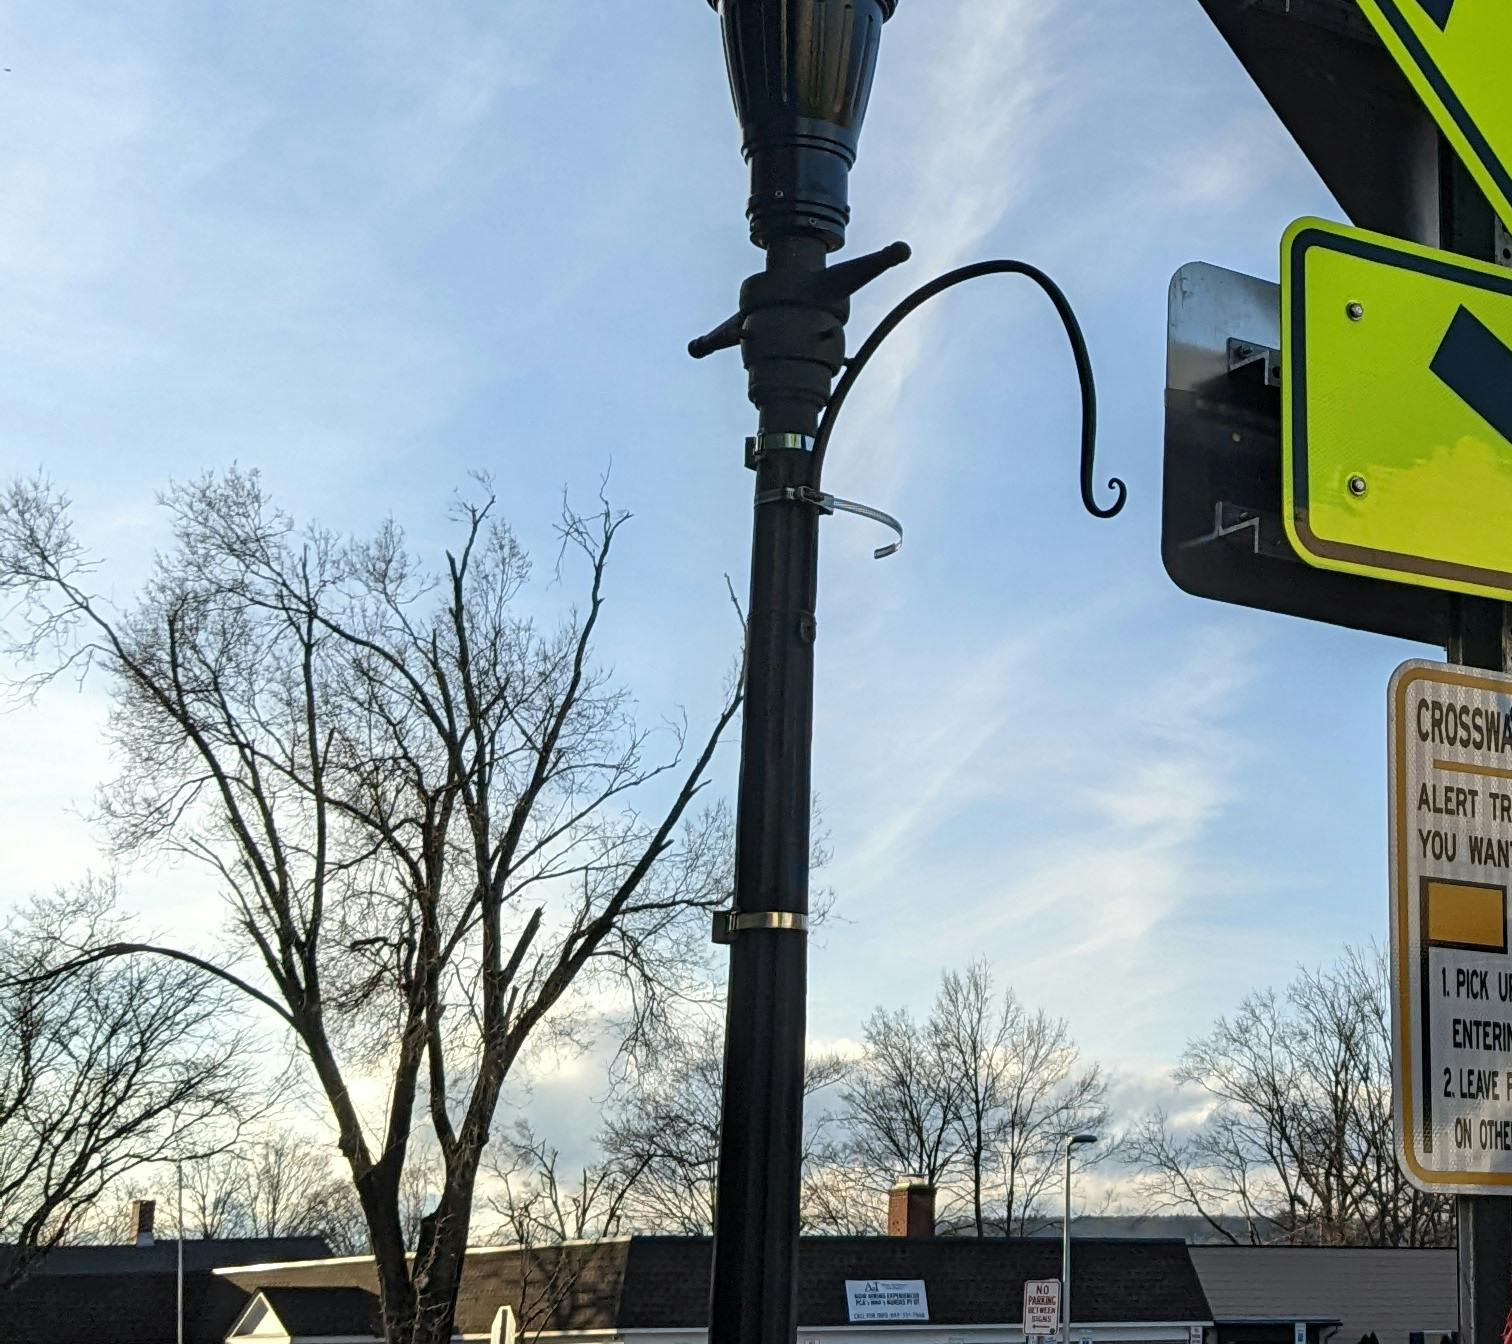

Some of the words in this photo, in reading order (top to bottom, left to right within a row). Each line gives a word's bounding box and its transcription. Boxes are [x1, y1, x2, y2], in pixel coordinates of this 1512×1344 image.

[1417, 782, 1478, 819] ALERT
[1417, 829, 1457, 863] YOU
[1441, 967, 1450, 998] 1.
[1456, 968, 1489, 1001] PICK
[1443, 1067, 1455, 1098] 2.
[1459, 1069, 1499, 1101] LEAVE
[1455, 1118, 1472, 1149] ON
[1028, 1296, 1056, 1306] PARKING
[1036, 1285, 1049, 1295] NO
